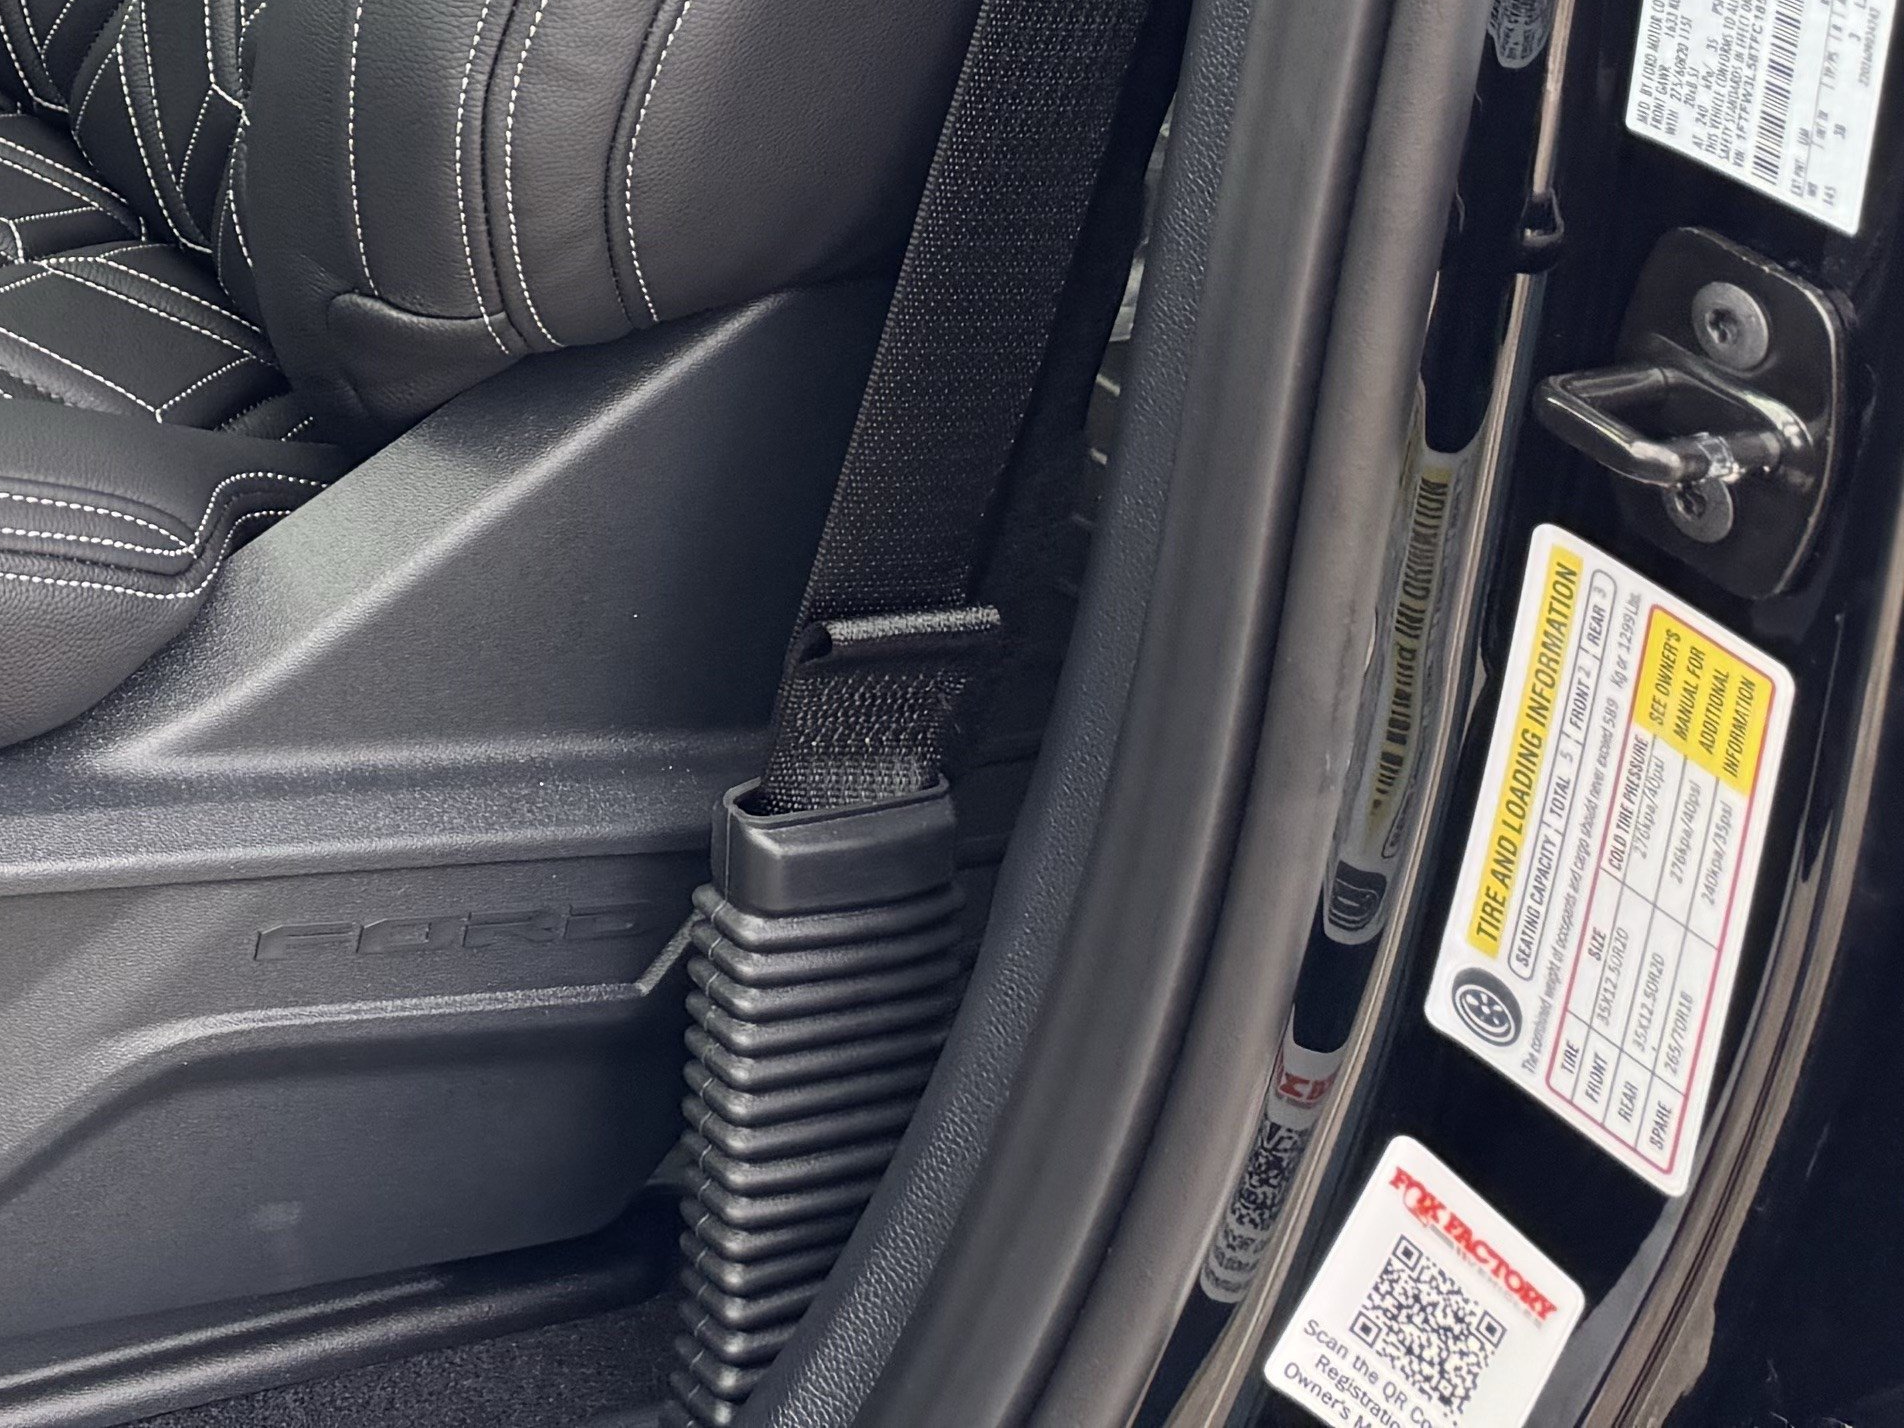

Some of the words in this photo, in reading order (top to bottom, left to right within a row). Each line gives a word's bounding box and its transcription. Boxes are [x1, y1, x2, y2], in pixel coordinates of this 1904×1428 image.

[1646, 14, 1663, 53] MOTOR
[1722, 15, 1737, 31] TO
[1734, 14, 1751, 50] EFFECT
[1641, 52, 1658, 82] FORD
[1714, 32, 1735, 89] CONFORMS
[1733, 49, 1745, 64] IN
[1638, 81, 1653, 98] BY
[1707, 90, 1726, 130] VEHICLE
[1723, 64, 1744, 126] STANDARDS
[1649, 96, 1667, 131] FRONT
[1664, 108, 1679, 136] WITH
[1694, 104, 1710, 127] 240
[1691, 133, 1705, 150] AT
[1704, 132, 1720, 157] THIS
[1717, 124, 1734, 162] SAFETY
[1525, 561, 1578, 729] INFORMATION
[1586, 603, 1606, 647] REAR
[1617, 612, 1636, 654] 1299
[1576, 665, 1592, 679] 2
[1609, 669, 1629, 689] Kg
[1616, 654, 1628, 671] or
[1654, 628, 1682, 697] OWNER'S
[1685, 645, 1706, 680] FOR
[1569, 678, 1591, 731] FRONT
[1648, 694, 1668, 727] SEE
[1672, 679, 1699, 743] MANUAL
[1697, 668, 1730, 756] ADDITIONAL
[1596, 725, 1614, 769] exceed
[1721, 675, 1756, 779] INFORMATION
[1558, 749, 1574, 764] 5
[1622, 734, 1649, 806] PRESSURE
[1501, 727, 1543, 836] LOADING
[1549, 775, 1571, 819] TOTAL
[1589, 766, 1606, 801] never
[1579, 796, 1599, 840] should
[1615, 802, 1634, 834] TIRE
[1490, 834, 1518, 891] AND
[1529, 833, 1557, 907] CAPACITY
[1573, 837, 1592, 872] cargo
[1608, 833, 1628, 872] COLD
[1568, 867, 1583, 894] and
[254, 900, 639, 960] FORD
[1475, 884, 1507, 943] TIRE
[1555, 892, 1578, 951] occupants
[1515, 904, 1541, 968] SEATING
[1550, 945, 1564, 964] of
[1587, 926, 1607, 962] SIZE
[1543, 959, 1562, 1000] weight
[1530, 996, 1553, 1055] combined
[1520, 1051, 1539, 1075] The
[1560, 1039, 1580, 1075] TIRE
[1584, 1051, 1608, 1104] FRONT
[1617, 1080, 1639, 1124] REAR
[1649, 1100, 1673, 1151] SPARE
[1389, 1166, 1447, 1227] FOX
[1442, 1211, 1557, 1321] FACTORY
[1303, 1318, 1350, 1361] Scan
[1352, 1353, 1380, 1386] the
[1382, 1380, 1410, 1414] QR
[1283, 1361, 1353, 1428] Owner's
